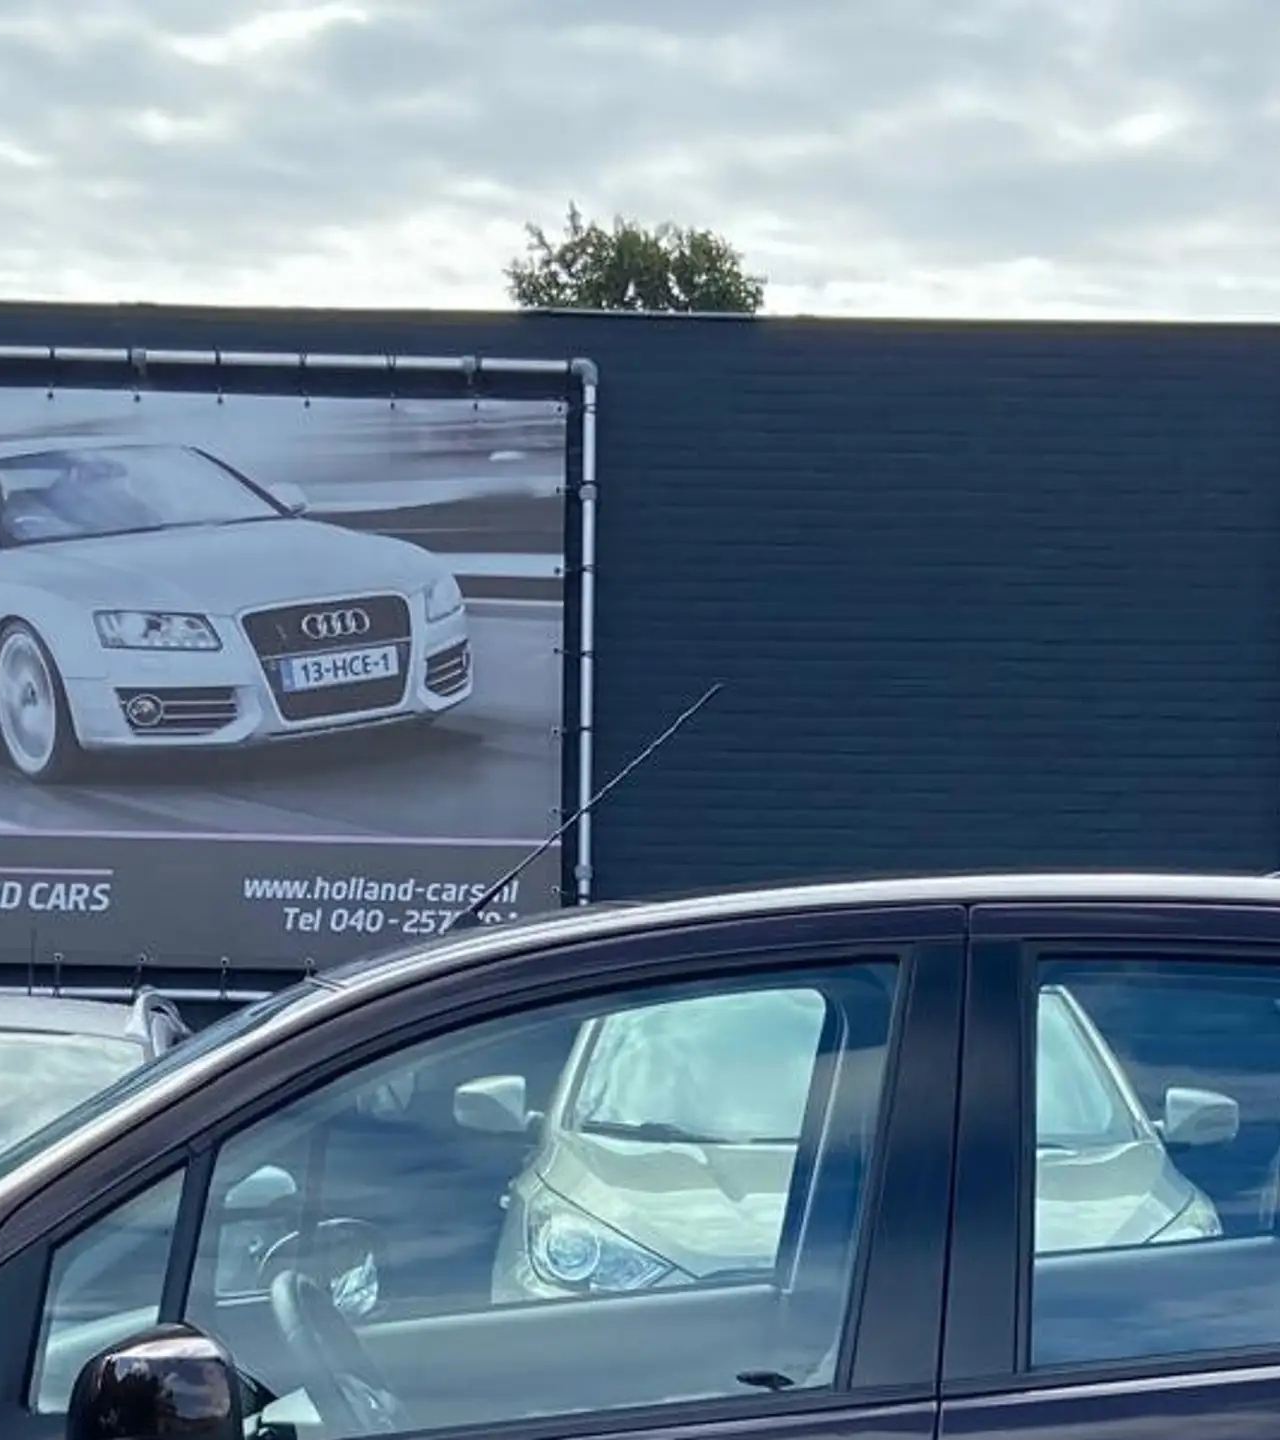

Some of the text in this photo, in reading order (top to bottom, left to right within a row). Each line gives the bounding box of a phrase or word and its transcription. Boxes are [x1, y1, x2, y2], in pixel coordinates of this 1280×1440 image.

[301, 652, 391, 683] 13-HCE-1
[27, 882, 112, 912] CARS
[243, 876, 520, 903] www.holland-carsnl
[282, 907, 322, 933] Tel
